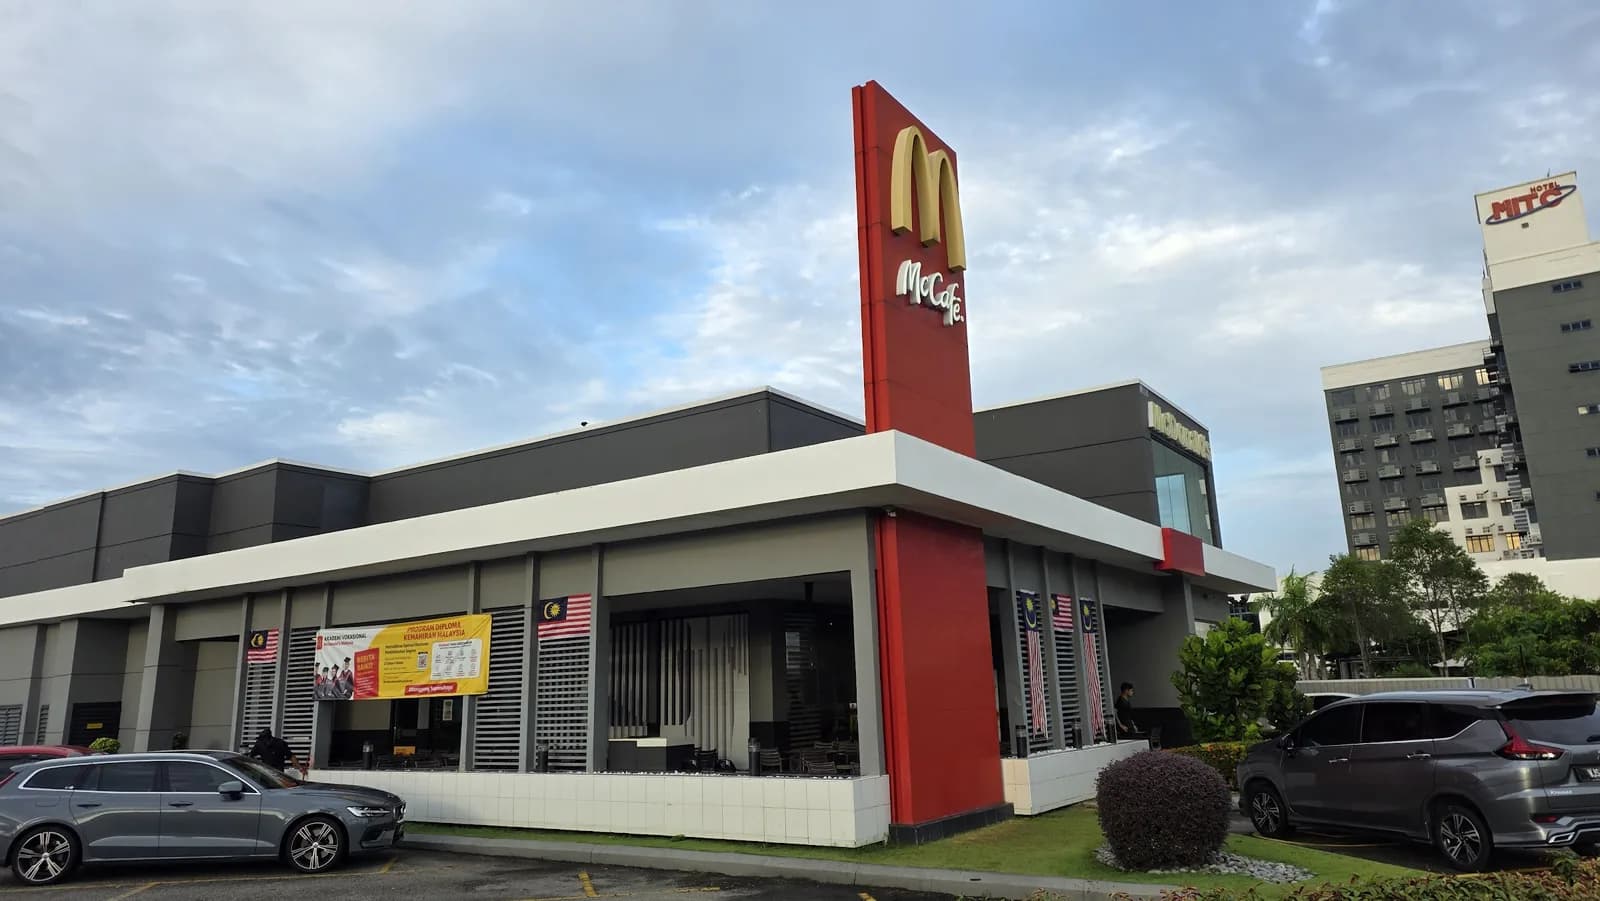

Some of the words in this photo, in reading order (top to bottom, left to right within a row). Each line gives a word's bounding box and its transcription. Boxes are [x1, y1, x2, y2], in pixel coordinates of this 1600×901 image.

[1530, 181, 1560, 193] HOTEL
[1491, 189, 1562, 220] MITC
[435, 621, 461, 631] DIPLOMA
[404, 632, 437, 640] KEMAHIRAN
[437, 629, 465, 638] MALAYSIA
